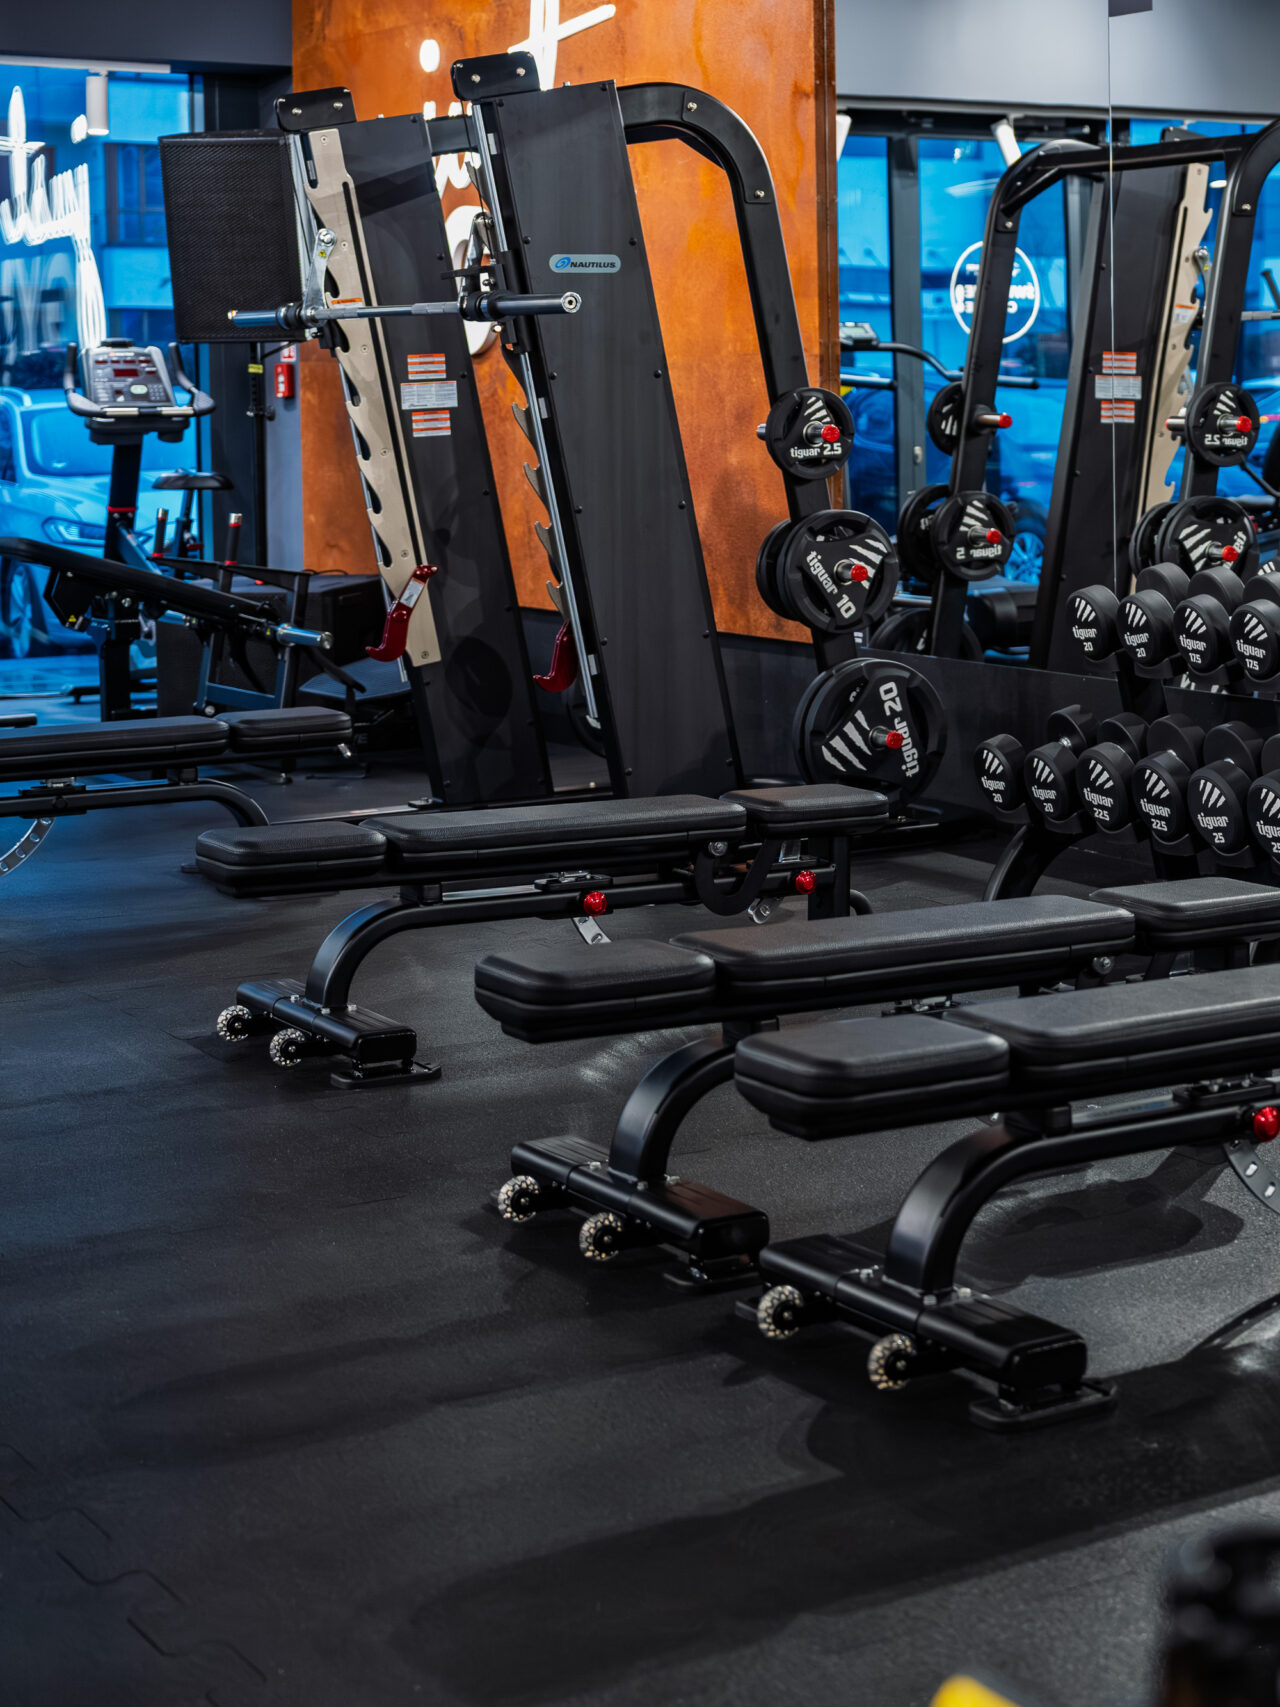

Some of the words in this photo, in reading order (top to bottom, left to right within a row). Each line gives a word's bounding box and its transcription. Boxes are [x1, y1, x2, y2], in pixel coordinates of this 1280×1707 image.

[790, 447, 821, 458] tiguar
[823, 443, 842, 455] 2.5
[806, 550, 838, 596] tiguar
[836, 594, 856, 619] 10
[1072, 625, 1098, 640] tiguar
[1124, 631, 1150, 646] tiguar
[1083, 642, 1094, 652] 20
[1179, 634, 1207, 652] tiguar
[1235, 639, 1266, 659] tiguar
[1136, 647, 1146, 658] 20
[879, 681, 903, 716] 20
[894, 717, 920, 778] tiguar
[981, 775, 1006, 791] tiguar
[992, 793, 1003, 803] 20
[1031, 785, 1057, 800] tiguar
[1083, 787, 1114, 808] tiguar
[1043, 802, 1054, 813] 20
[1139, 798, 1171, 818] tiguar
[1197, 812, 1229, 830] tiguar
[1212, 832, 1225, 844] 25
